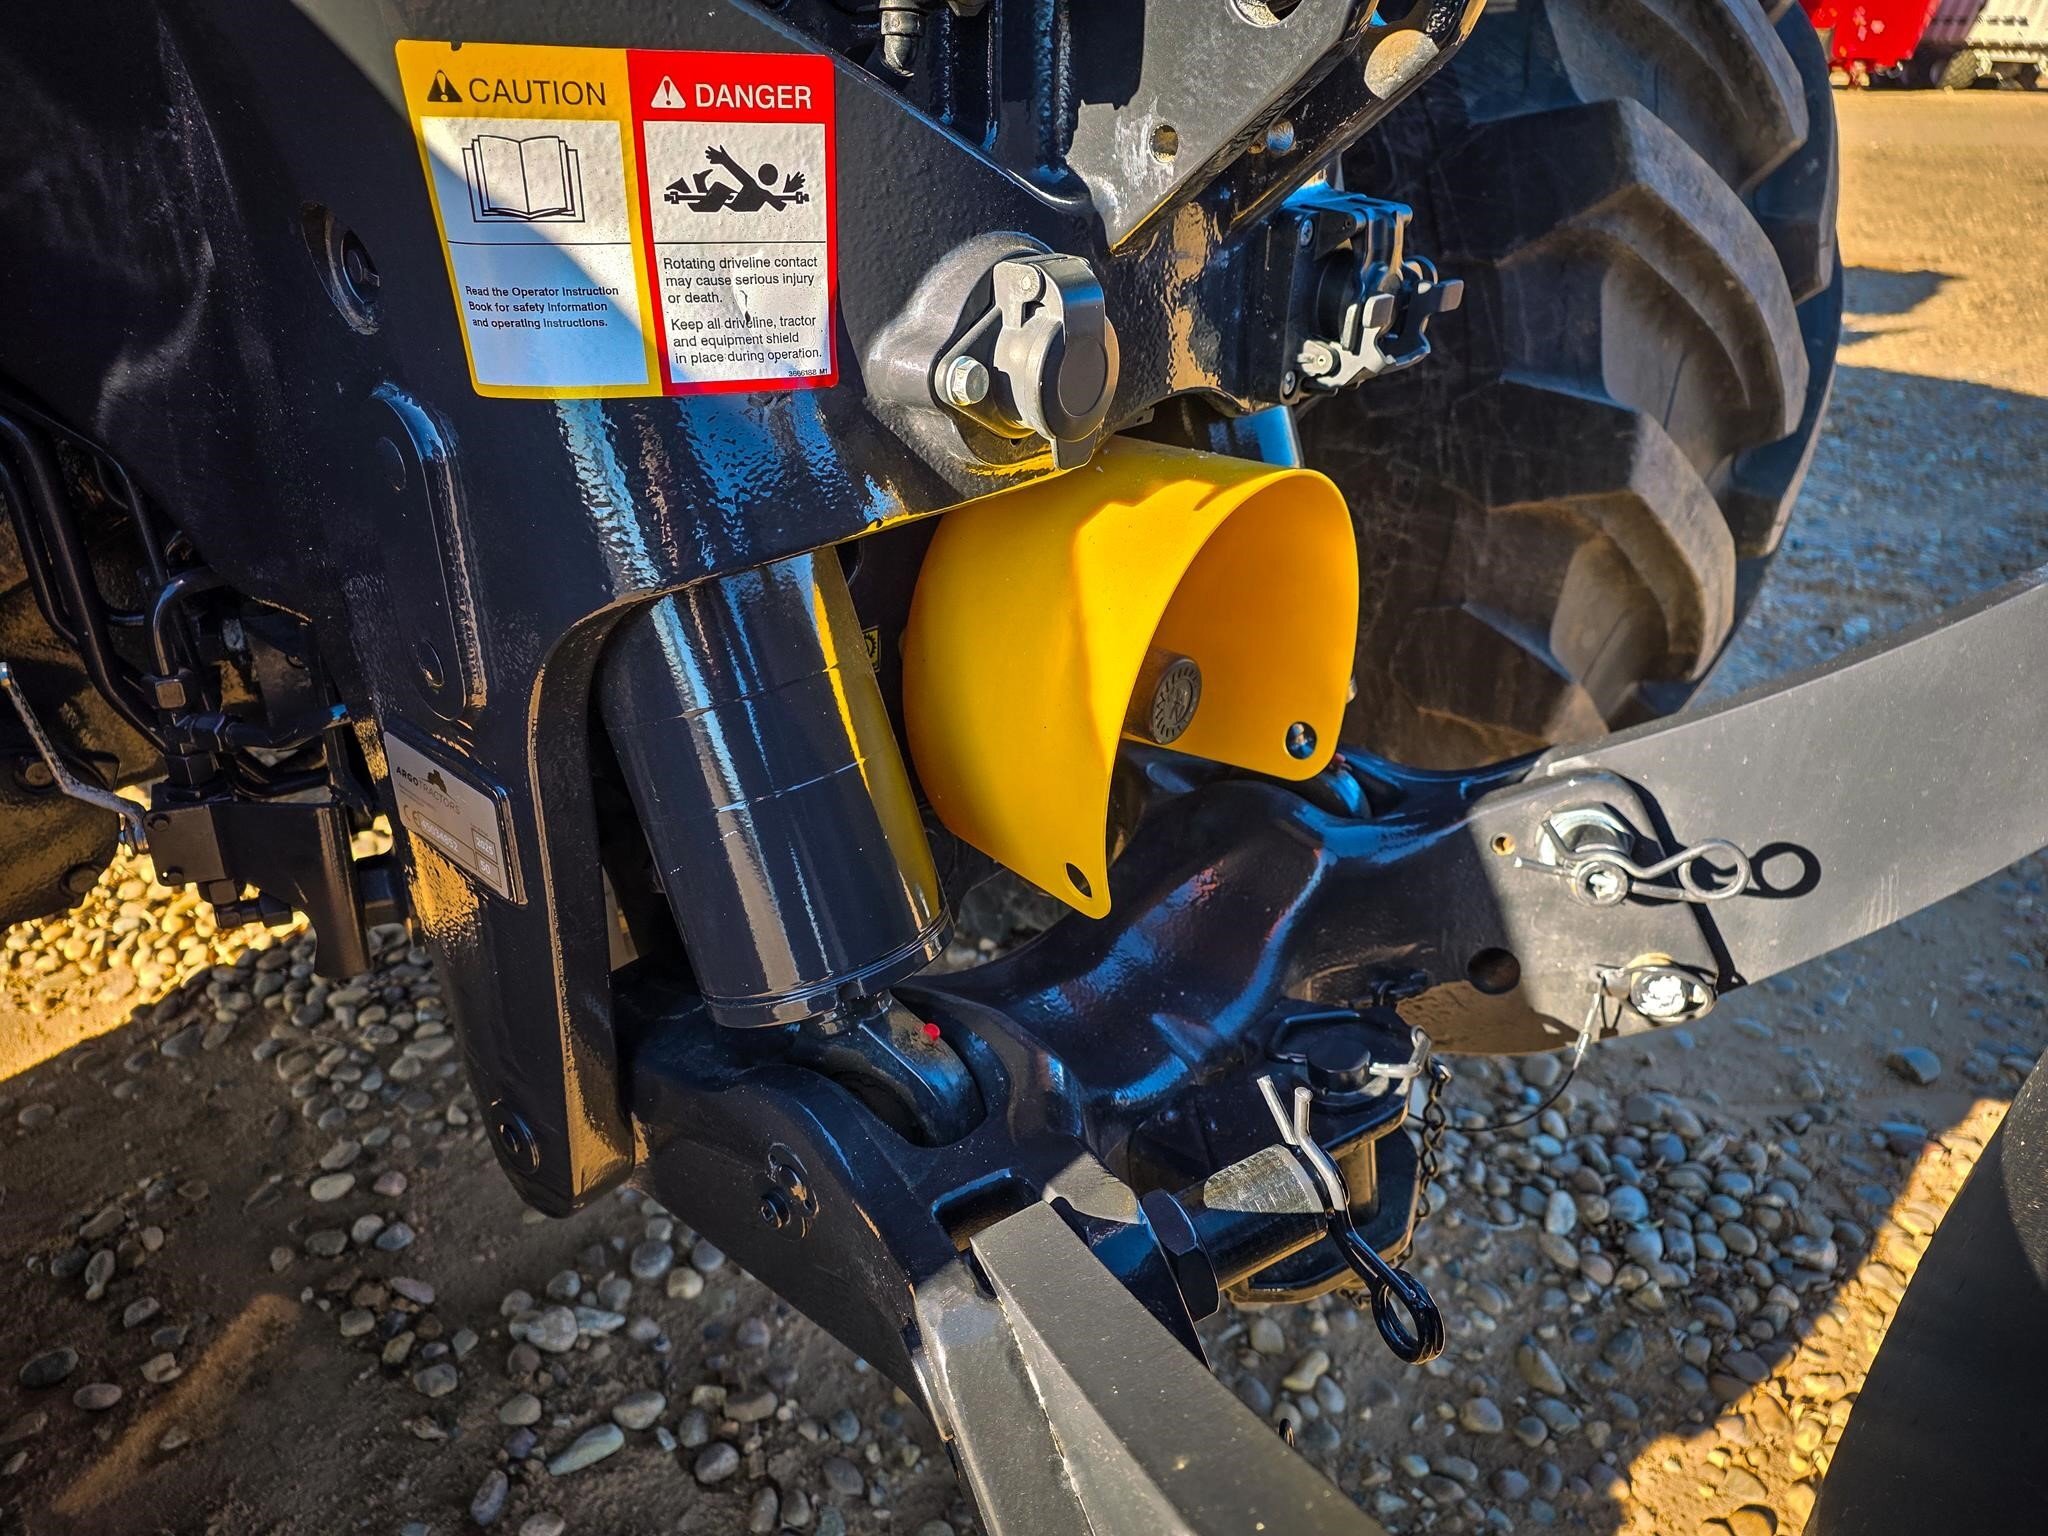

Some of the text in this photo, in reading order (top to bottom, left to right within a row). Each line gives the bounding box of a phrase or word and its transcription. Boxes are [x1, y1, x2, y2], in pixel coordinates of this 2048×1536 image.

[469, 77, 607, 106] CAUTION
[695, 83, 812, 109] DANGER
[663, 256, 818, 271] Rotating driveline contact
[666, 273, 815, 288] may cause serious injury
[465, 285, 489, 296] Read
[492, 287, 508, 296] the
[511, 287, 560, 298] Operator
[667, 292, 723, 303] or death.
[468, 301, 493, 311] Book
[495, 302, 509, 312] for
[513, 302, 545, 313] safety
[472, 318, 489, 327] and
[491, 317, 541, 330] operating
[670, 315, 816, 332] Keep all driveline, tractor
[673, 332, 799, 349] and equipment shield
[675, 348, 822, 366] in place during operation.
